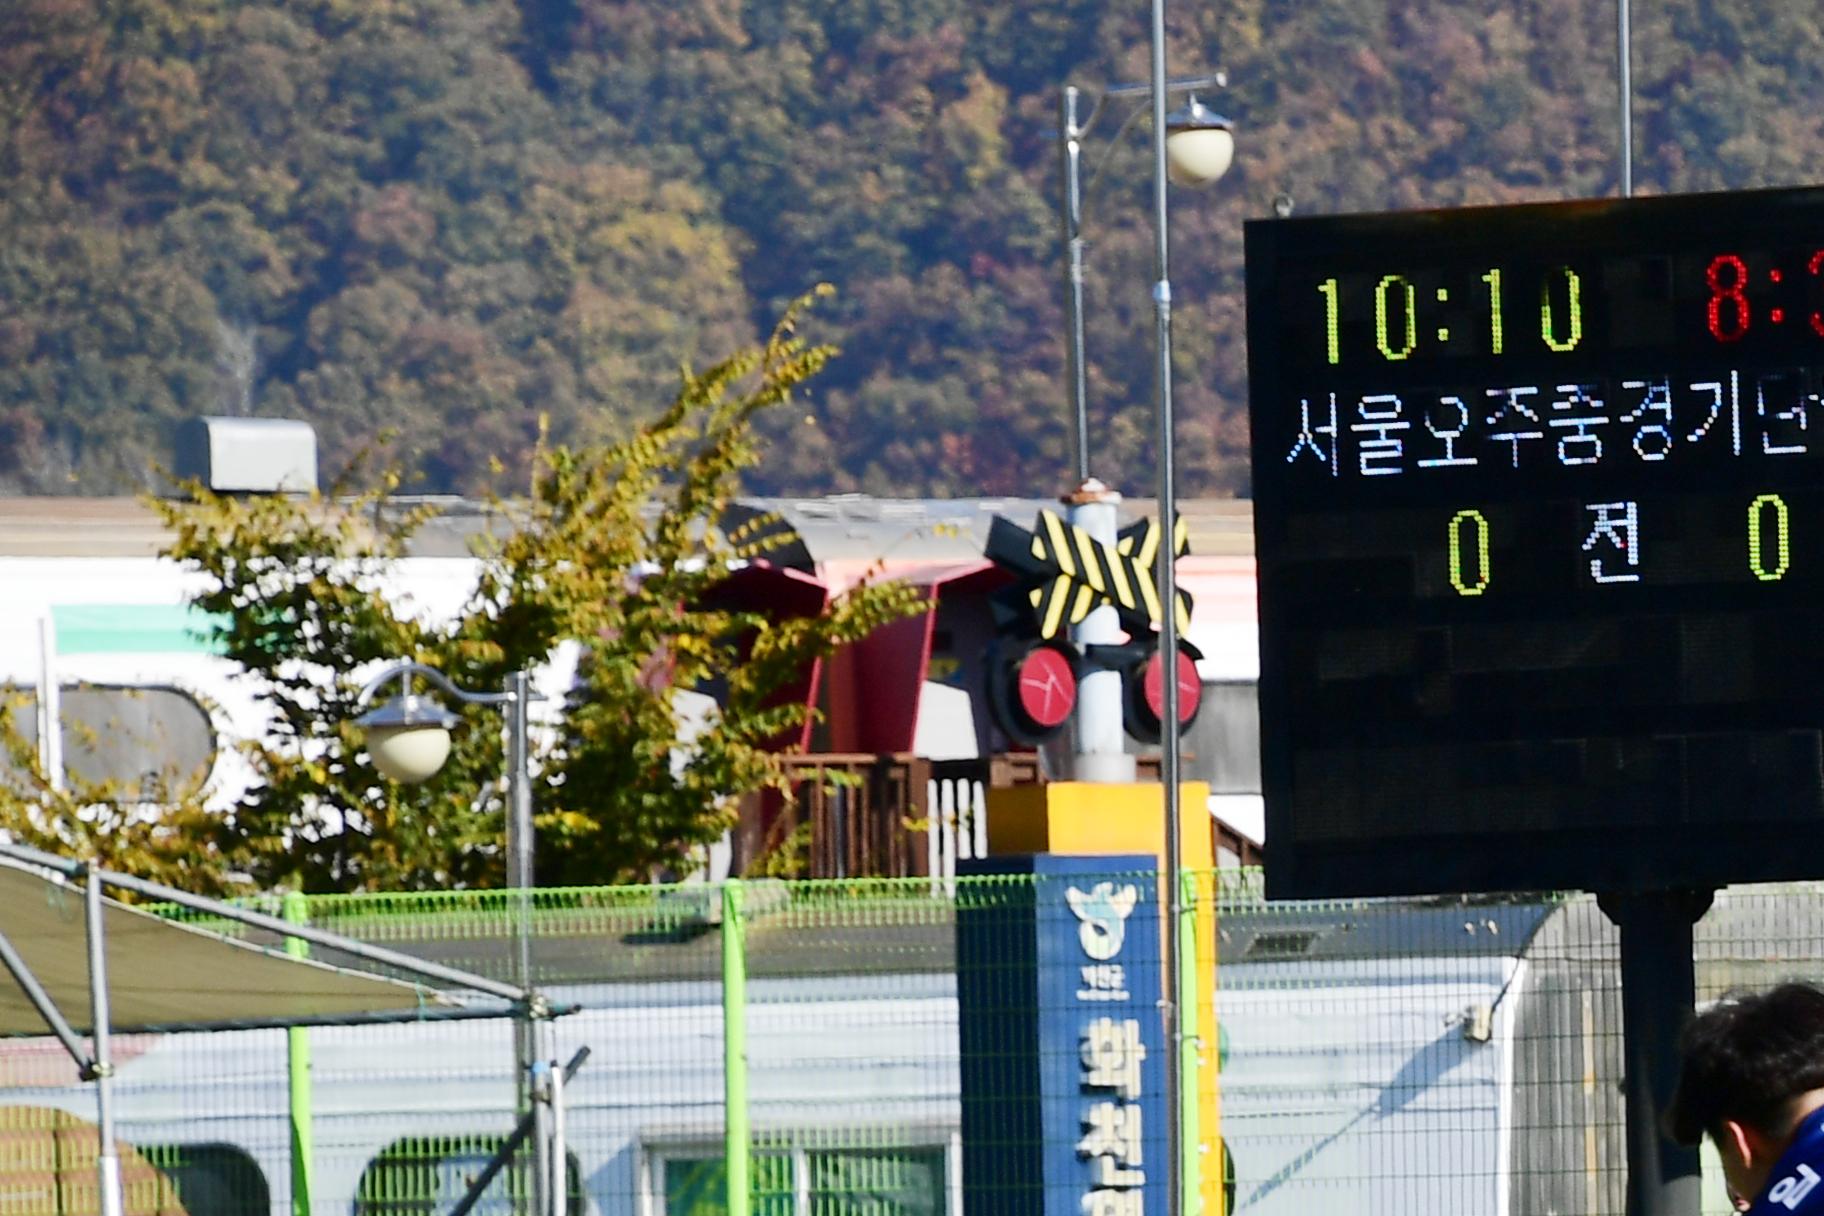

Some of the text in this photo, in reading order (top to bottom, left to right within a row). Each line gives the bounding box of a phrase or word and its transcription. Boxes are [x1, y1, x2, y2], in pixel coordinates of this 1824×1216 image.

[1318, 265, 1582, 363] 10:10
[1448, 494, 1789, 596] 0 전 0
